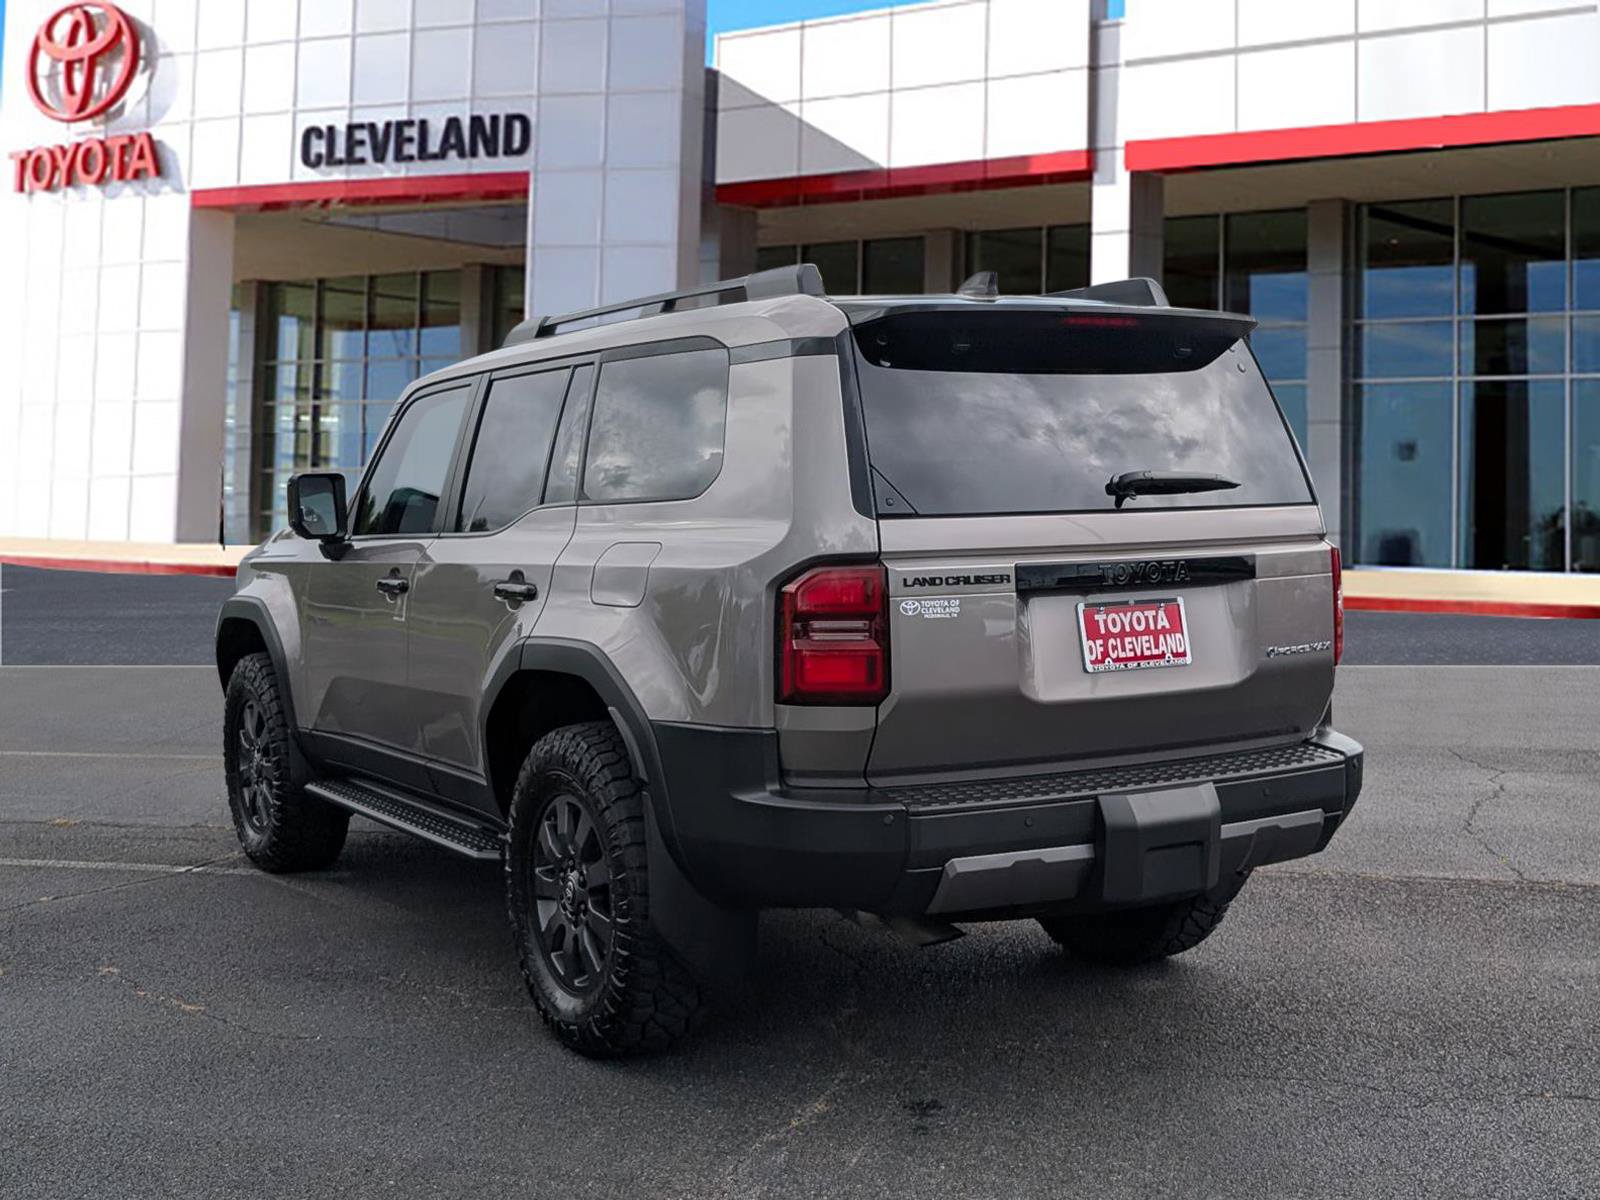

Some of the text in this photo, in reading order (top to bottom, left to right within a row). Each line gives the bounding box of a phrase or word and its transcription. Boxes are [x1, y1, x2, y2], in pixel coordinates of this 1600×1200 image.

[301, 113, 531, 169] CLEVELAND
[9, 132, 161, 193] TOYOTA
[903, 574, 1011, 587] LAND CRUISER
[1098, 560, 1191, 585] TOYOTA
[921, 606, 961, 614] CLEVELAND
[1094, 610, 1170, 634] TOYOTA
[1086, 633, 1185, 660] OF CLEVELAND
[1092, 664, 1126, 672] TOYOTA
